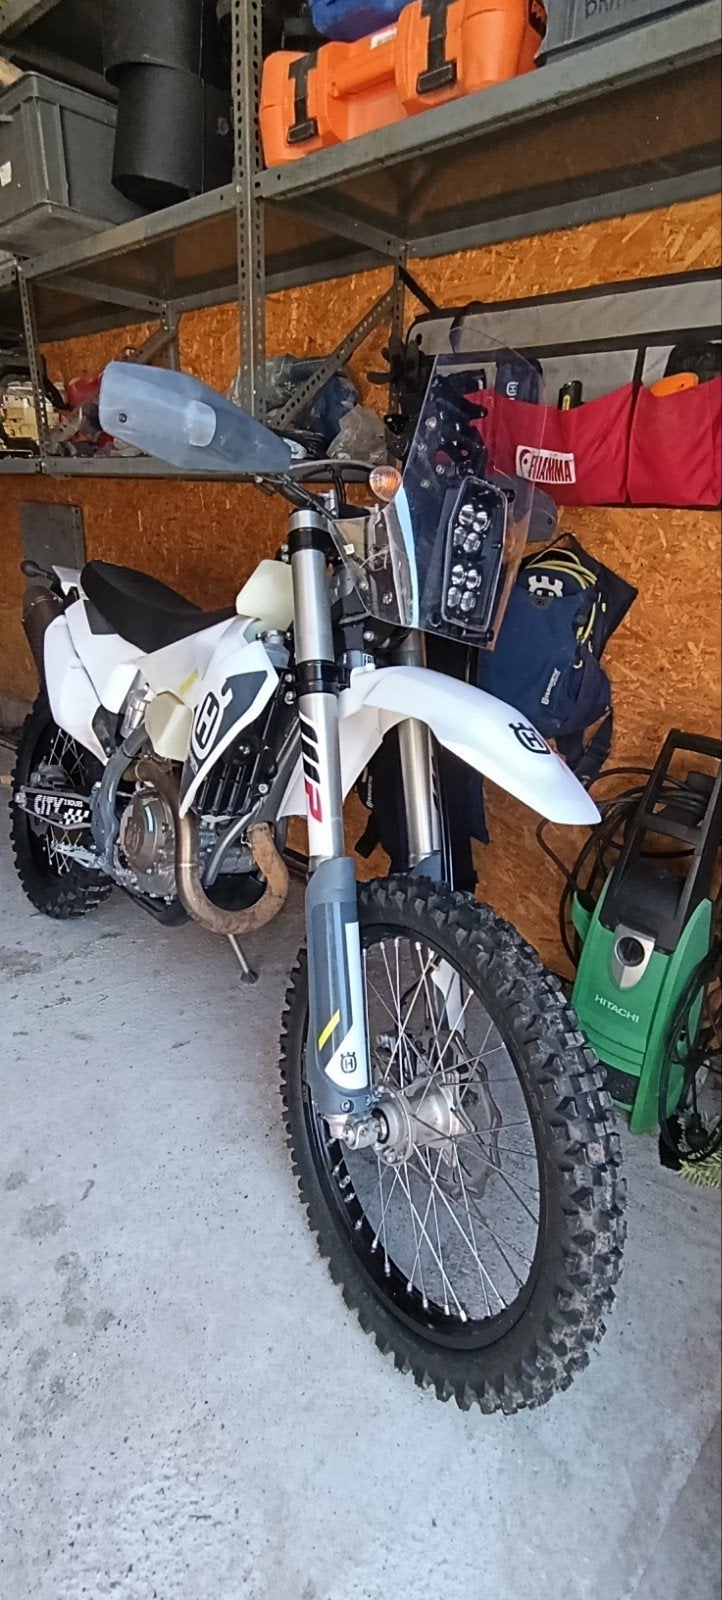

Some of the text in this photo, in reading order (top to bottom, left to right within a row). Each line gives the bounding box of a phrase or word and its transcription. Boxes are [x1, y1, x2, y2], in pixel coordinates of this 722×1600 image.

[528, 454, 572, 482] FIAMMA
[34, 794, 64, 816] CITY
[595, 994, 640, 1023] HITACHI
